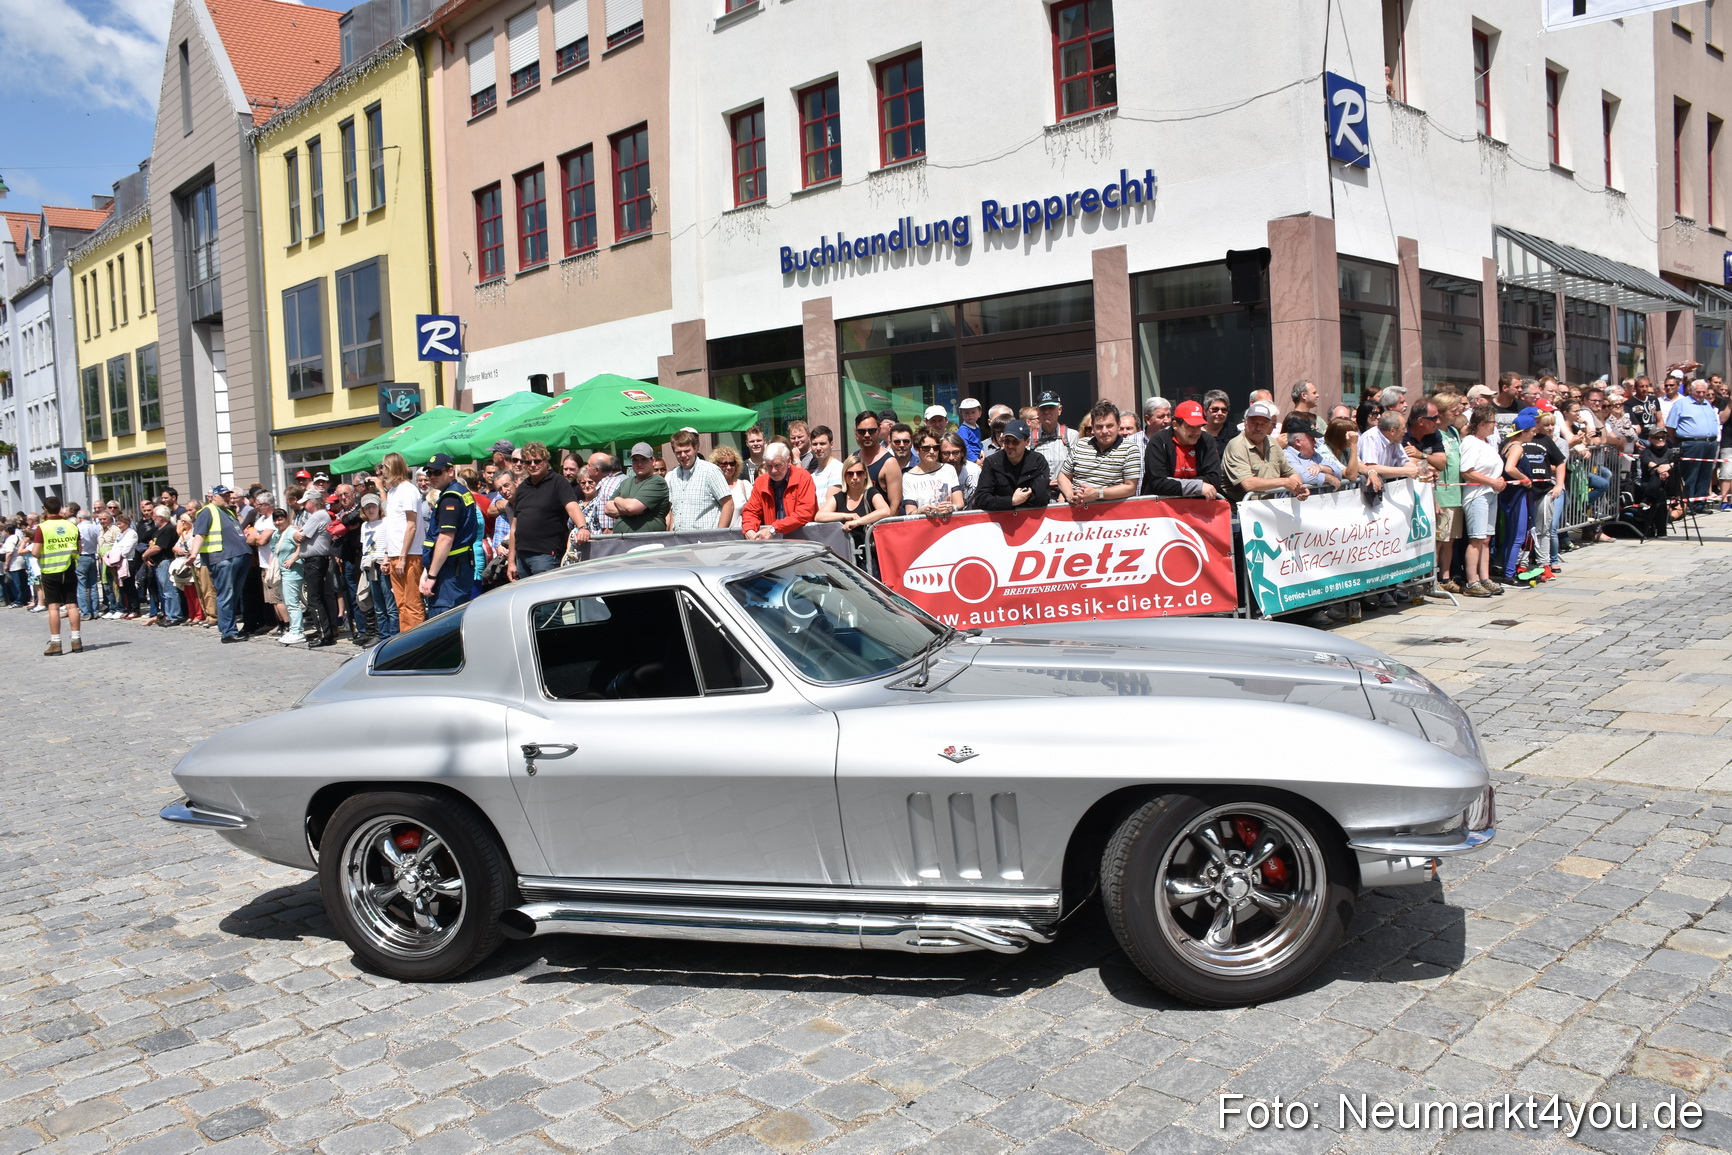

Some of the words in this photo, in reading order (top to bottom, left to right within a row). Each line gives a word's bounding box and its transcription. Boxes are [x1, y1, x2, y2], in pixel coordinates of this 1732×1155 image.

[780, 214, 971, 275] Buchhandlung
[981, 168, 1158, 234] Rupprecht
[480, 371, 493, 380] Markt
[493, 368, 498, 378] 15
[396, 394, 411, 412] G2
[48, 536, 77, 544] FOLLOW
[1040, 522, 1150, 545] Autoklassik
[1304, 527, 1339, 549] UNS
[1346, 537, 1402, 564] BESSER
[1008, 543, 1145, 583] Dietz
[1003, 582, 1078, 597] BREITENBRUNN
[1283, 588, 1323, 603] Service-Line:
[937, 590, 1213, 626] w.autoklassik-dietz.de
